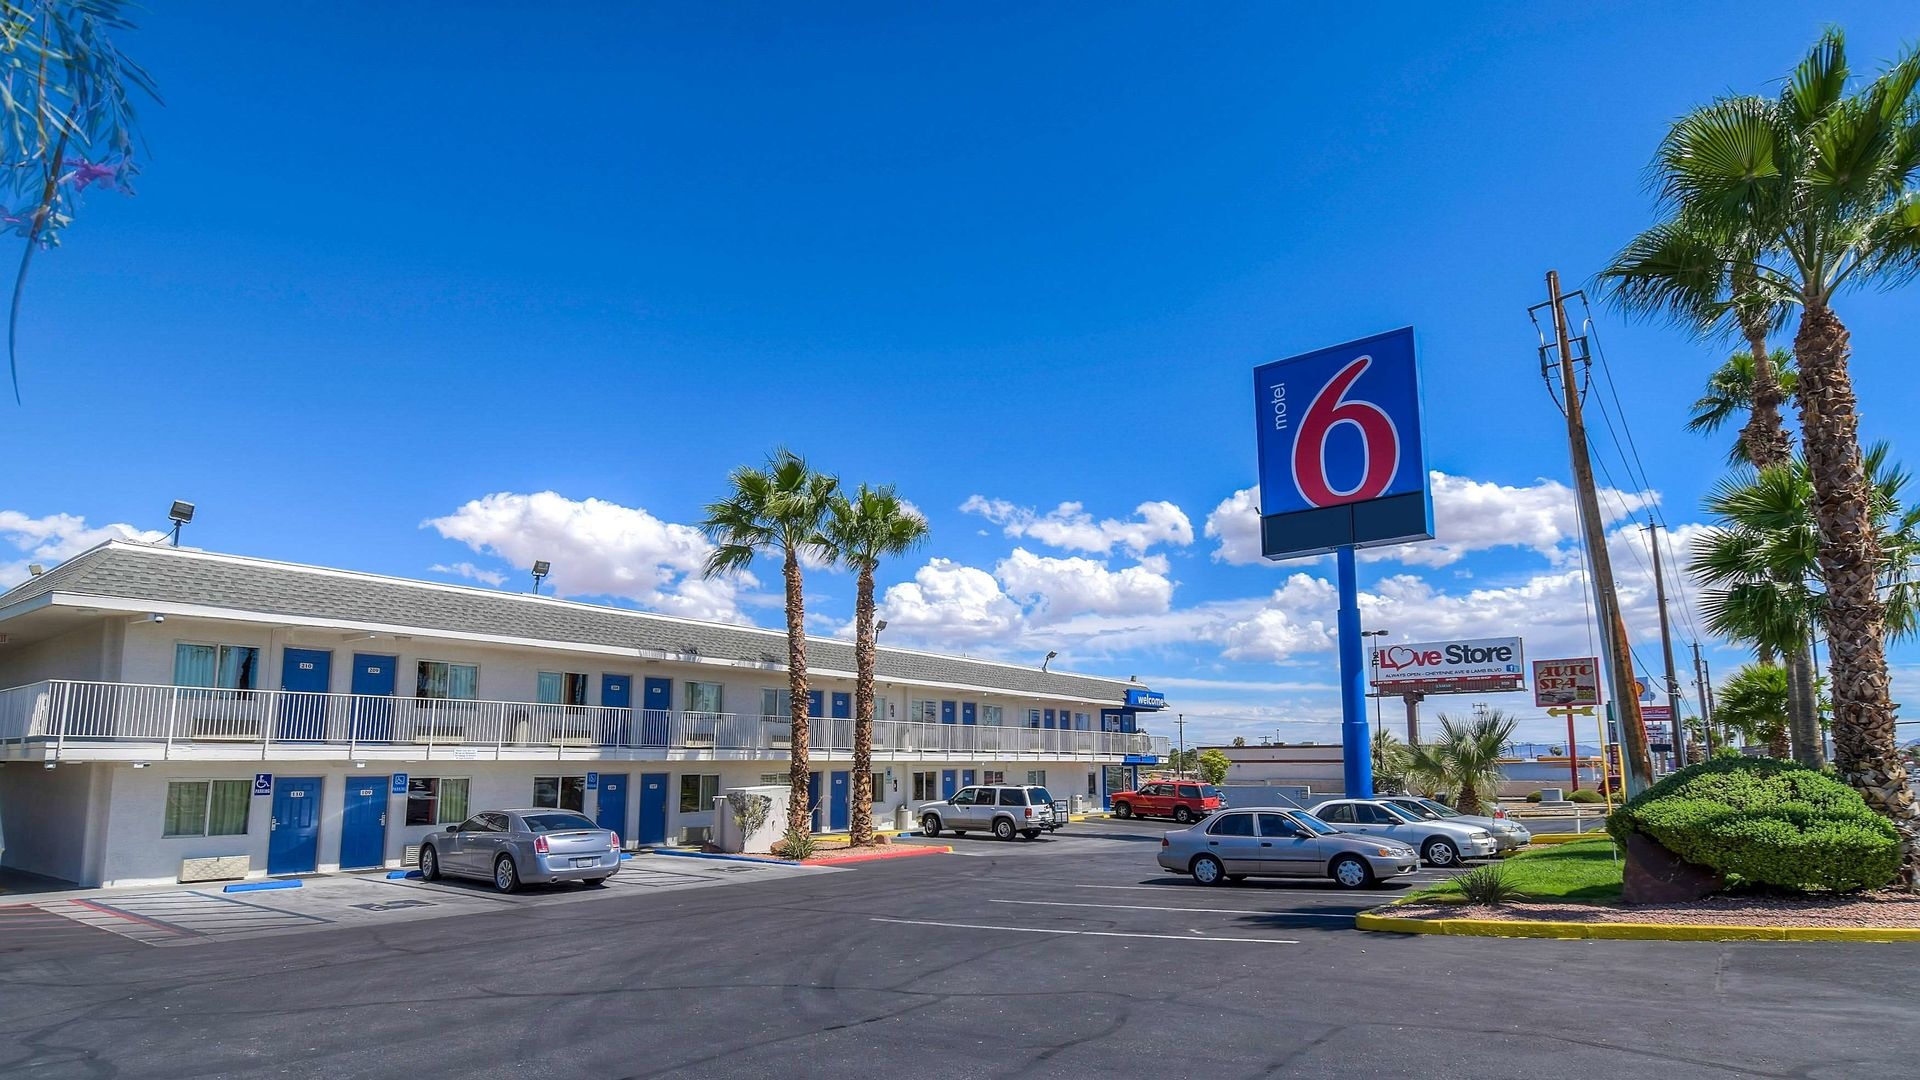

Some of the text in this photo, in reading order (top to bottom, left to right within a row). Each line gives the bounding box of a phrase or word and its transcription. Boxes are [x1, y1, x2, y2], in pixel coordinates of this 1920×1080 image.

[1270, 382, 1287, 430] motel
[1291, 354, 1400, 508] 6
[1379, 646, 1443, 671] Love
[1445, 644, 1512, 665] Store
[1538, 665, 1593, 679] AUTO
[1539, 677, 1576, 690] SPA
[1137, 693, 1164, 706] welcome
